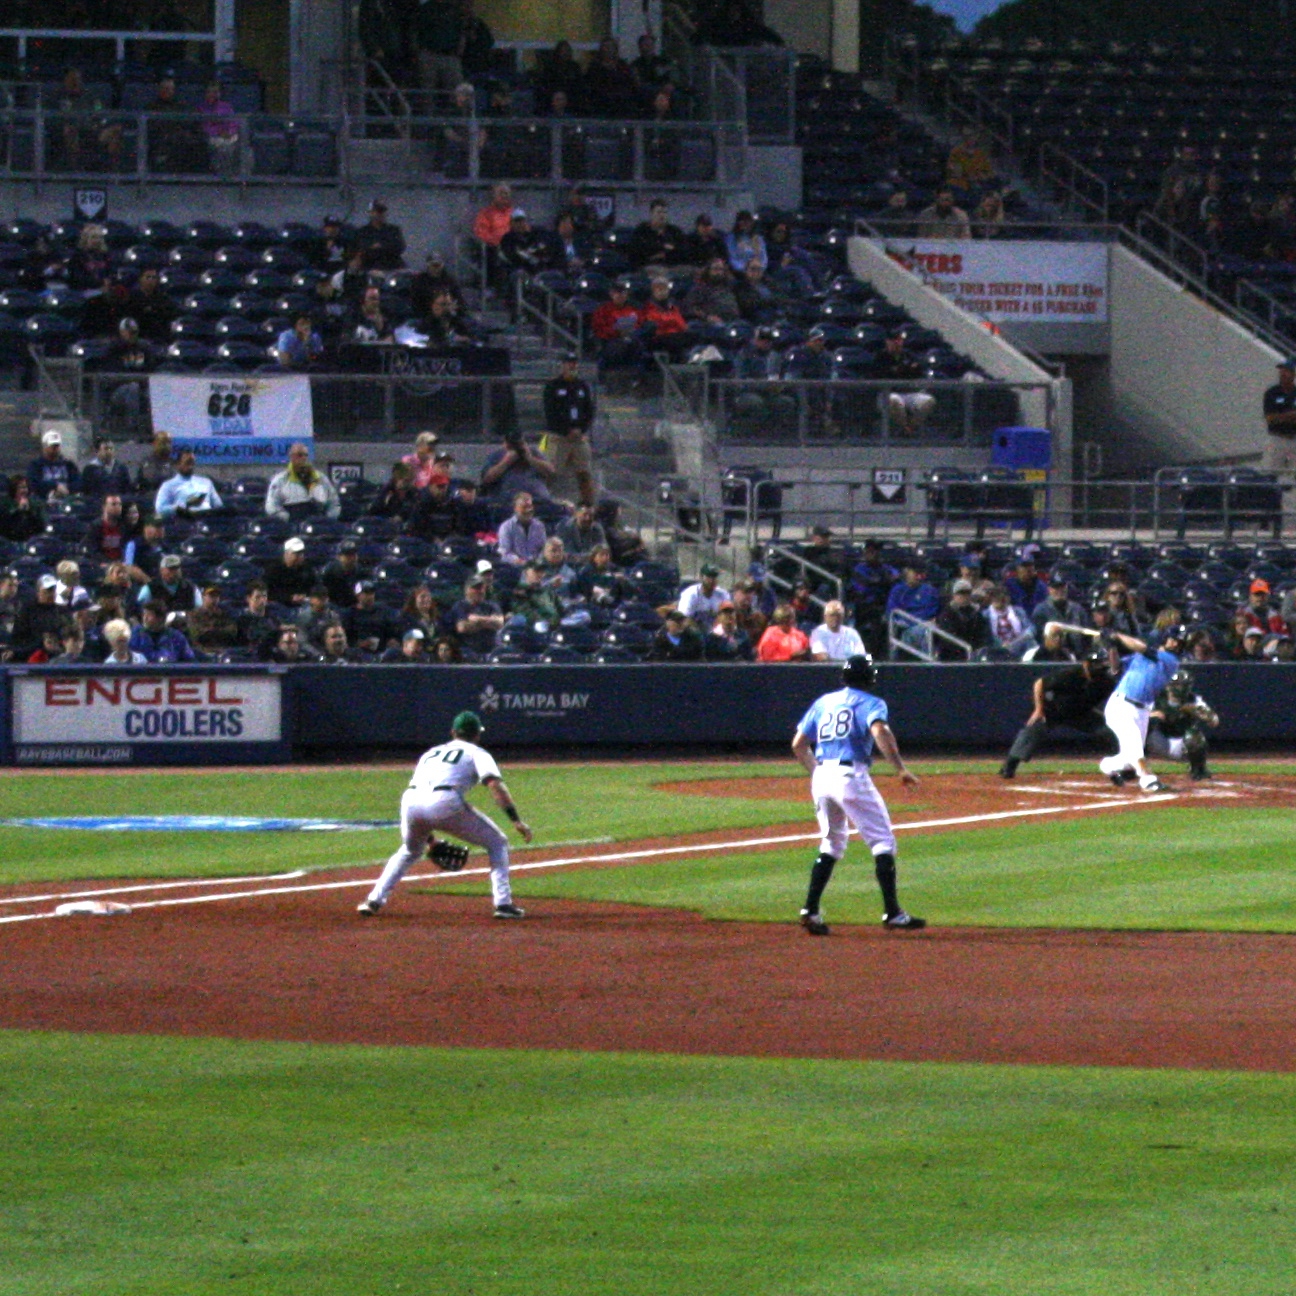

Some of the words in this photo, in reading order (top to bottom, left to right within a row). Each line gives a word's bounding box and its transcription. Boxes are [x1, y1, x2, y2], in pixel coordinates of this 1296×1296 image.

[45, 676, 243, 706] ENGEL
[502, 693, 556, 709] TAMPA
[560, 693, 590, 709] BAY
[125, 708, 243, 738] COOLERS
[819, 708, 853, 741] 28
